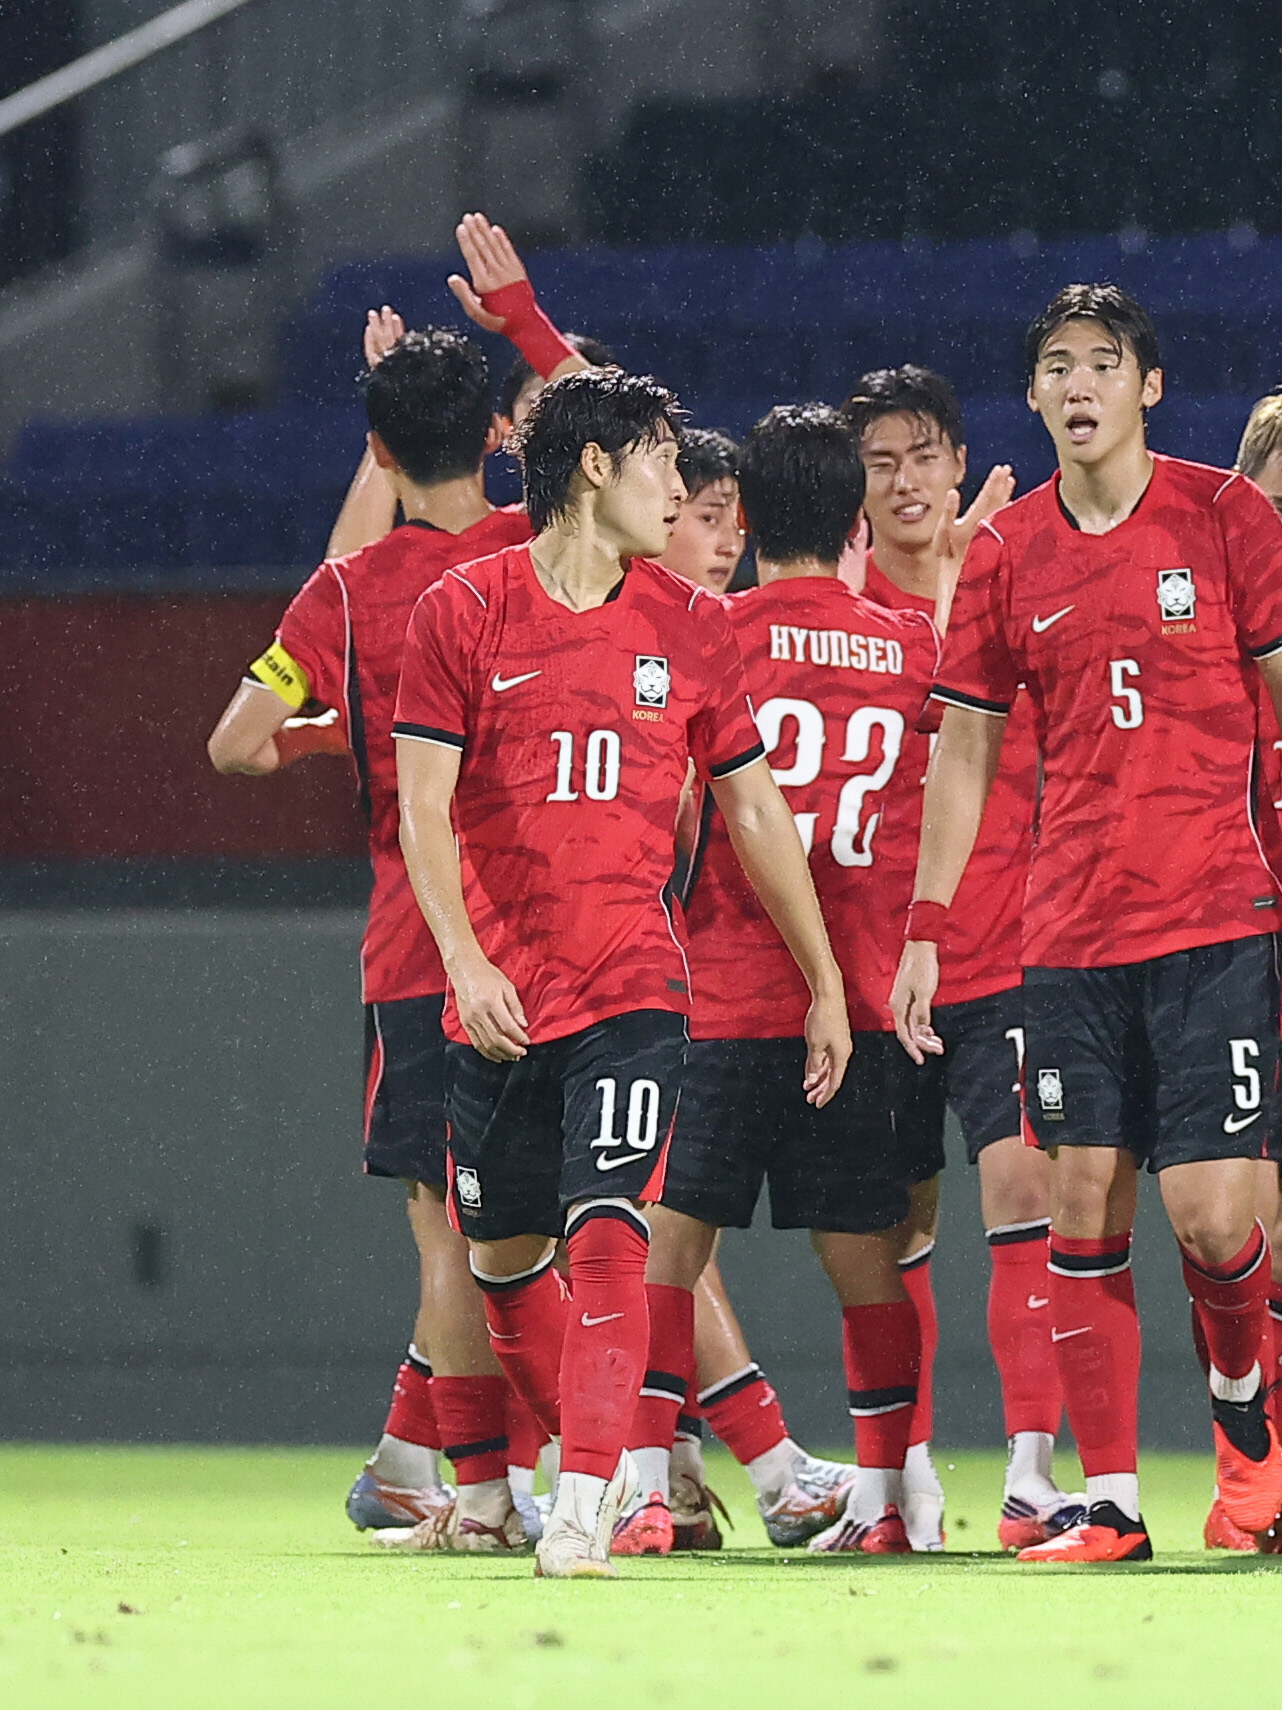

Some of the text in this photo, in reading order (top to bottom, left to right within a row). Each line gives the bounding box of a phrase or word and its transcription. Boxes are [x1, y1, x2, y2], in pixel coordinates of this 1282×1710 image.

[769, 624, 904, 675] HYUNSEO
[1161, 623, 1197, 635] KOREA
[632, 709, 664, 723] KOREA
[1109, 659, 1144, 729] 5
[546, 730, 620, 803] 10
[756, 697, 905, 867] 22
[1229, 1039, 1261, 1110] 5
[590, 1077, 660, 1150] 10
